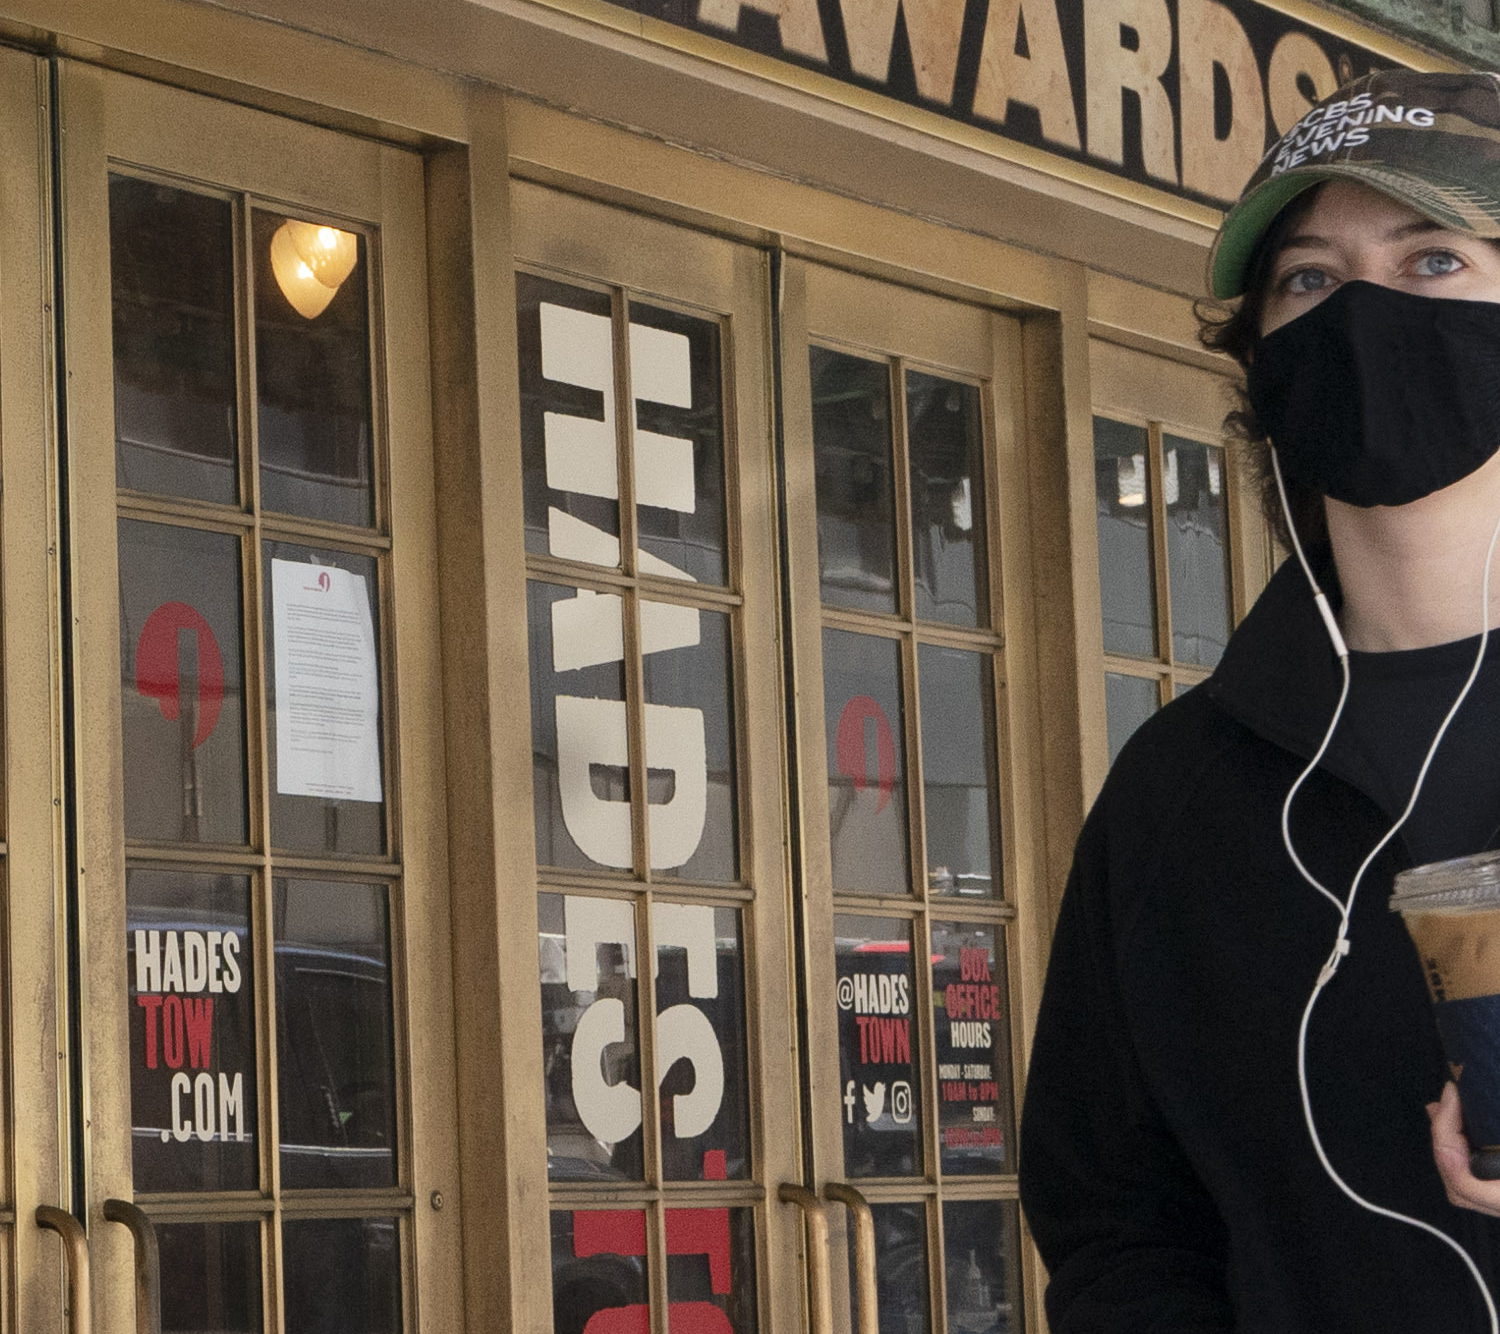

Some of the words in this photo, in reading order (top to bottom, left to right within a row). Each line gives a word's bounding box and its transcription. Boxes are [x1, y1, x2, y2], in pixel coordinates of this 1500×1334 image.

[1271, 127, 1371, 177] NEWS
[1274, 105, 1436, 164] EVENING
[135, 929, 242, 994] HADES
[959, 947, 993, 982] BOX
[837, 973, 910, 1015] @HADES
[945, 984, 1001, 1021] OFFICE
[137, 995, 214, 1070] TOW
[856, 1017, 911, 1065] TOWN
[950, 1021, 992, 1050] HOURS
[161, 1071, 244, 1144] .COM
